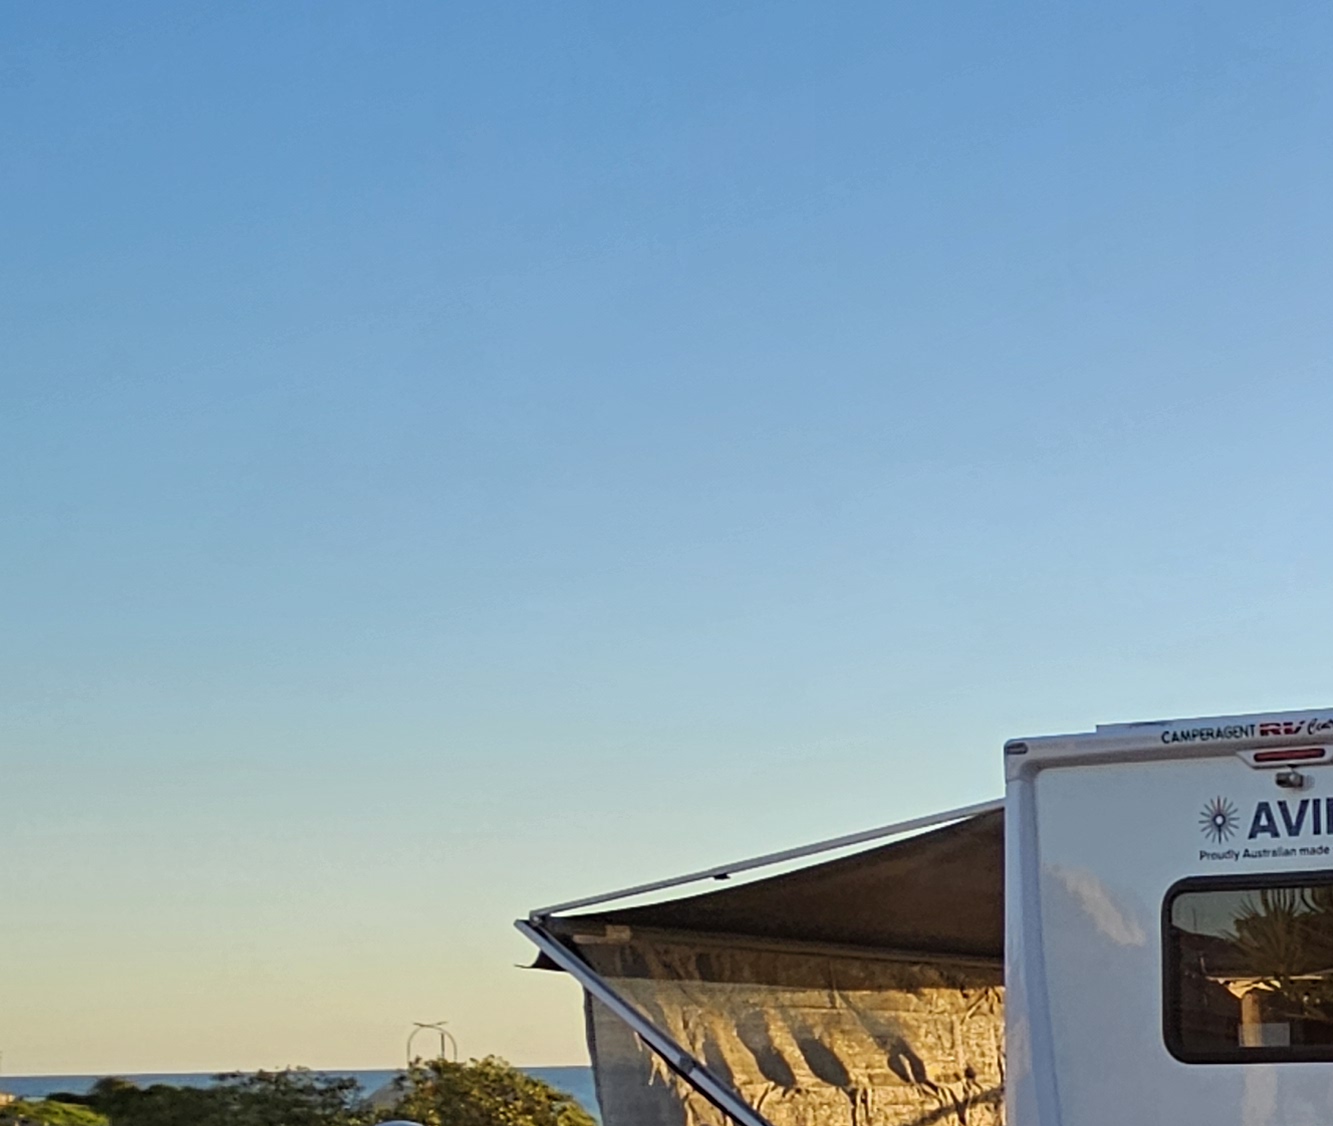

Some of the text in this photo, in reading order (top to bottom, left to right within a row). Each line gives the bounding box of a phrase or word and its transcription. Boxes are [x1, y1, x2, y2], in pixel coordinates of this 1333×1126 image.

[1161, 724, 1256, 744] CAMPERAGENT
[1200, 849, 1240, 862] Proudly
[1242, 848, 1298, 860] Australian
[1299, 845, 1330, 856] made
